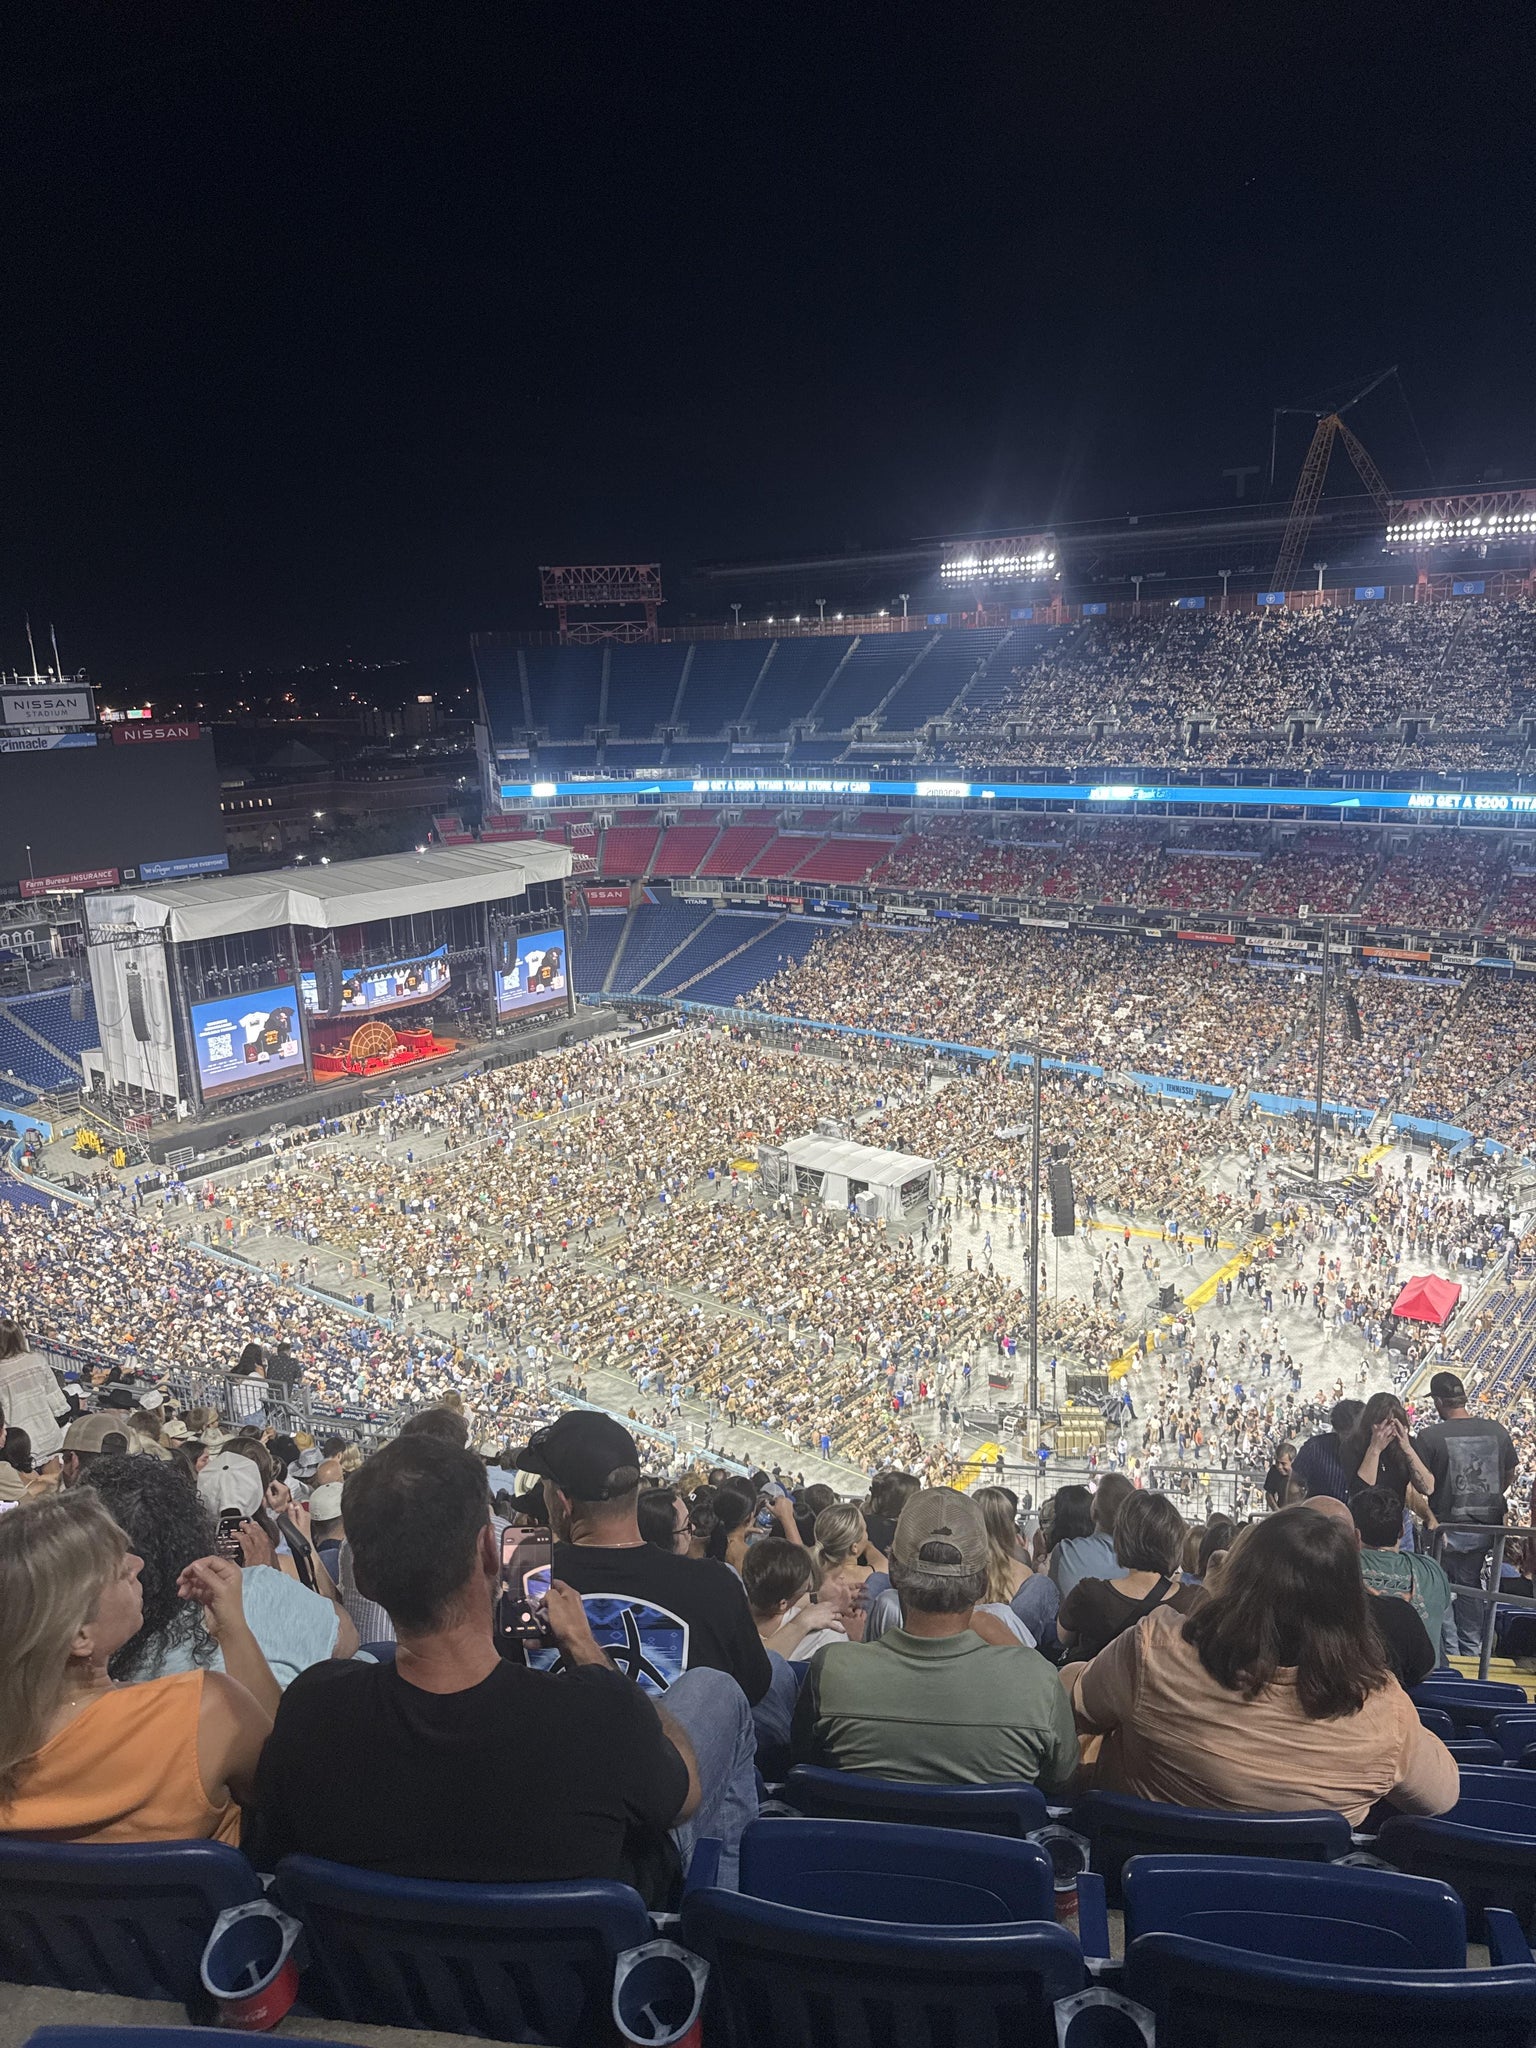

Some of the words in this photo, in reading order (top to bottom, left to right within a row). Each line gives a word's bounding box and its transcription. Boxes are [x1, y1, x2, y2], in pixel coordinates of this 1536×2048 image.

[13, 699, 77, 710] NISSAN
[25, 710, 69, 718] STADIUM
[124, 727, 189, 740] NISSAN
[2, 738, 48, 751] Pinnacle
[1408, 793, 1435, 808] AND
[1436, 794, 1462, 808] GET
[1462, 796, 1472, 808] A
[1474, 795, 1509, 810] $200
[26, 880, 44, 888] Farm
[45, 877, 69, 886] Bureau
[70, 870, 113, 882] INSURANCE
[1442, 955, 1472, 965] Pinnacle
[1166, 1083, 1194, 1096] TENNESSEE
